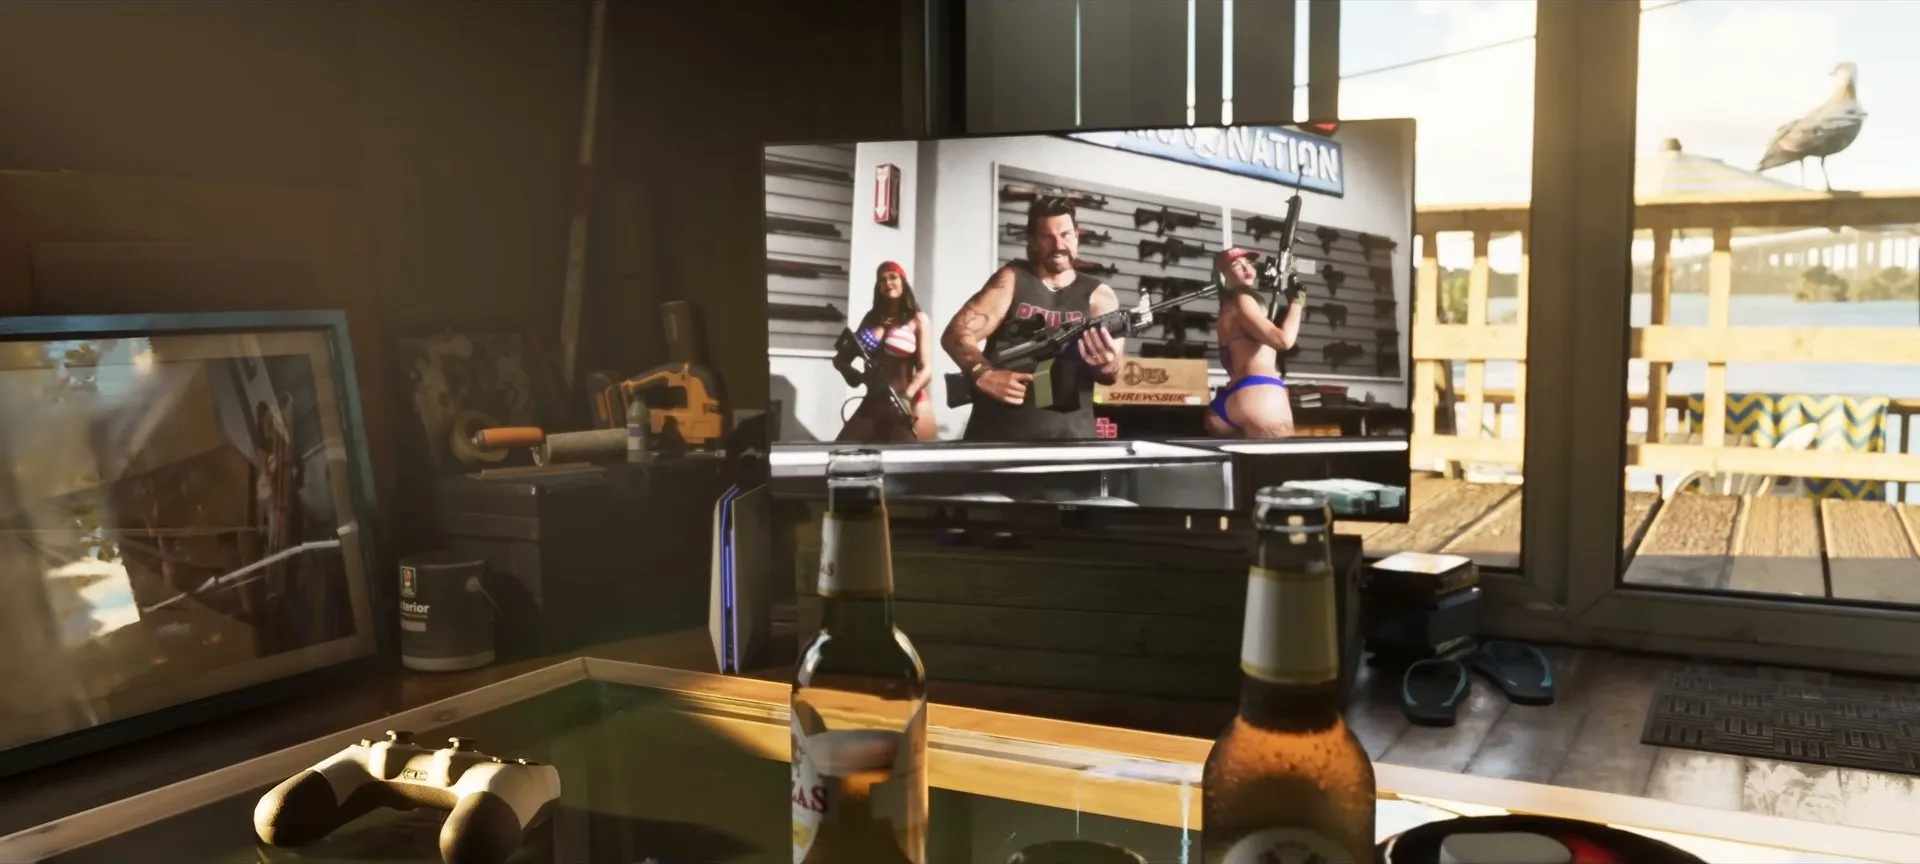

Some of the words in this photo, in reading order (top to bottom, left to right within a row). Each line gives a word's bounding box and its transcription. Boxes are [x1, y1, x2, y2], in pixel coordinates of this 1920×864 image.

[1227, 126, 1338, 183] NATION
[400, 600, 430, 613] terior
[792, 785, 828, 813] AS
